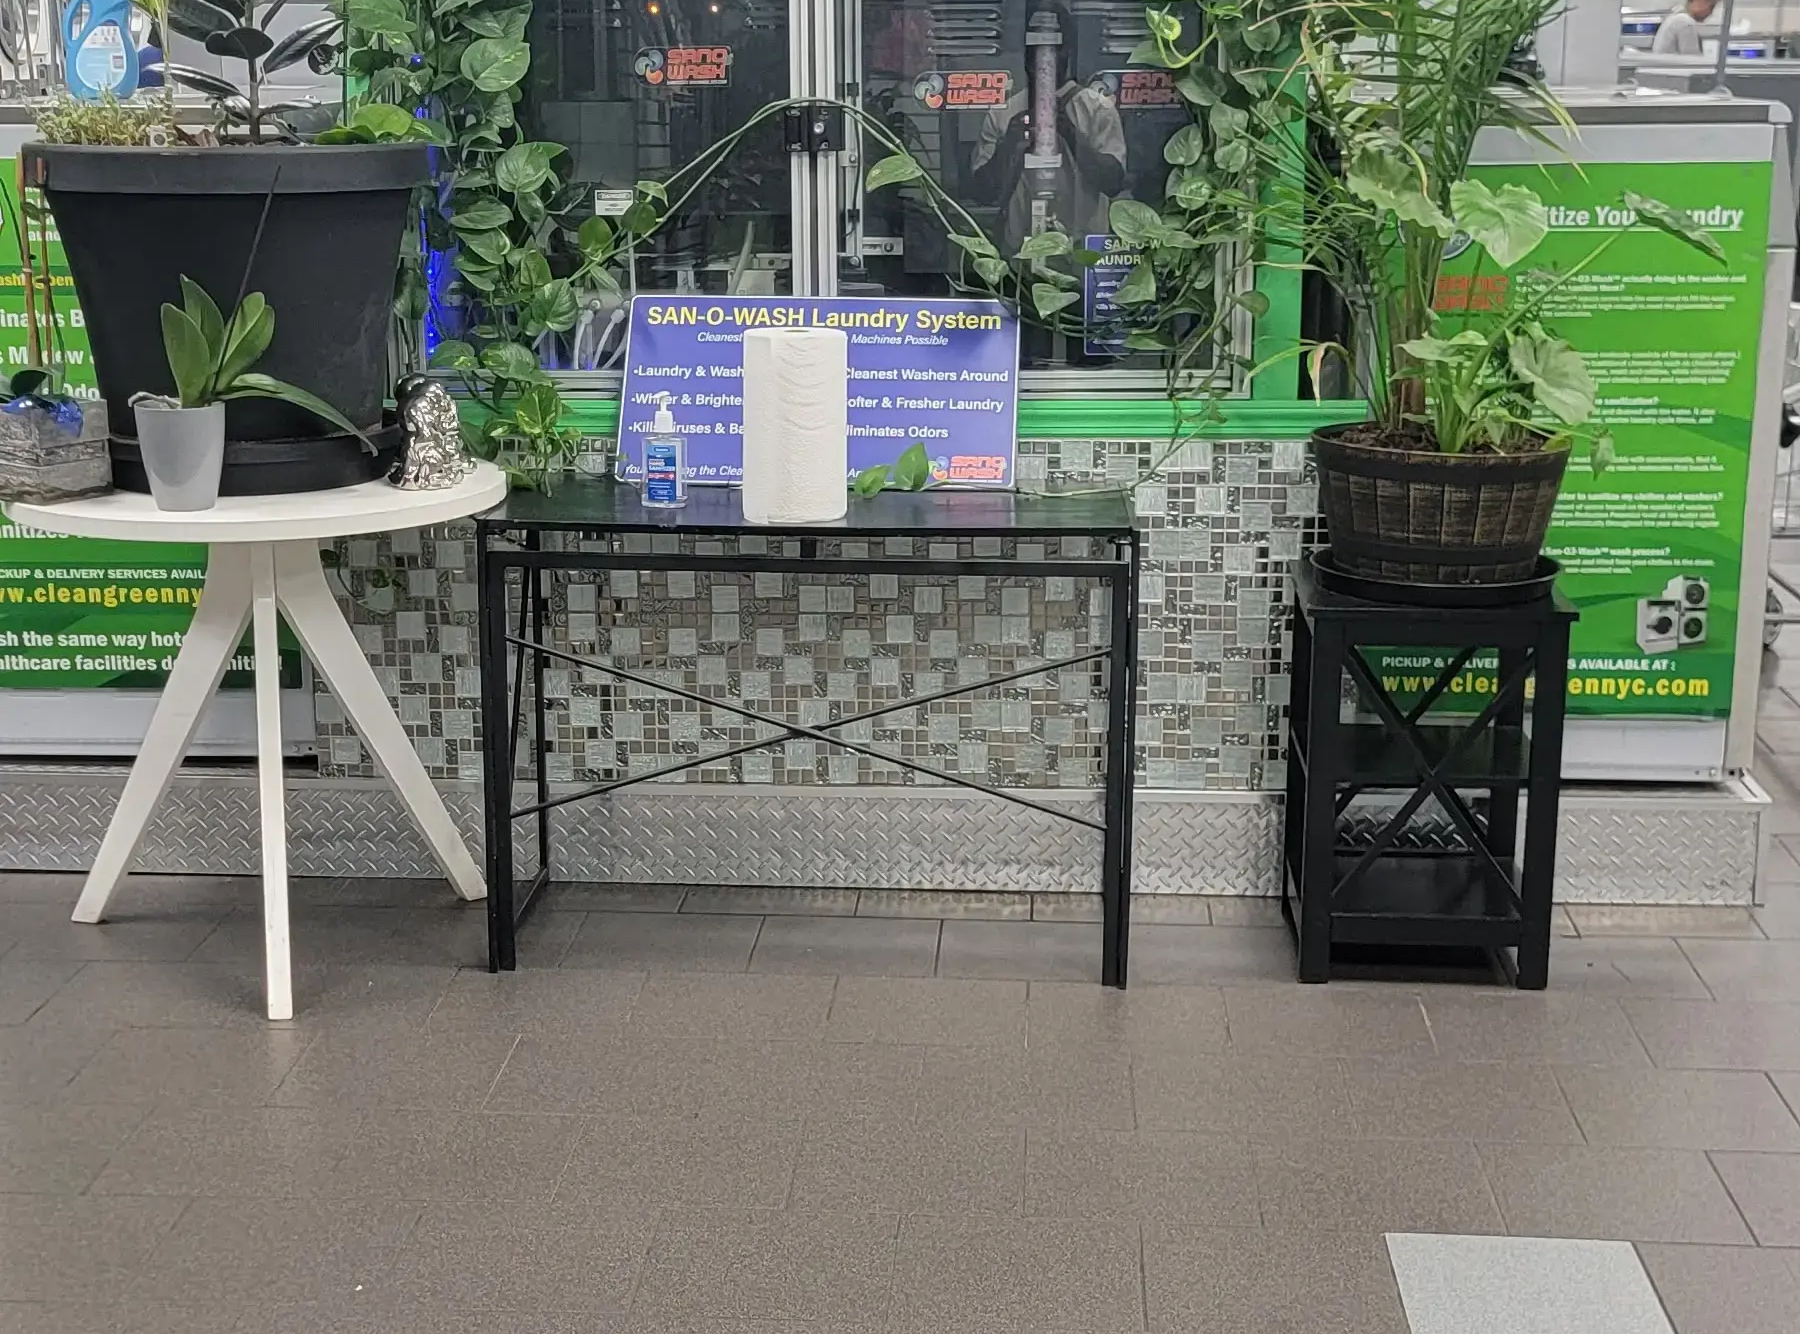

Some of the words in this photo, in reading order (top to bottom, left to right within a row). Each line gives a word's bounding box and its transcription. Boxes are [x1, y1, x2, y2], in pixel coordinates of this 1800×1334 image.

[668, 49, 727, 63] SANO
[667, 65, 726, 79] WASH
[947, 73, 1007, 88] SANO
[947, 89, 1005, 103] WASH
[1595, 205, 1638, 226] You
[1692, 205, 1744, 230] ndry
[647, 306, 804, 326] SAN-O-WASH
[813, 308, 910, 333] Laundry
[916, 310, 1001, 334] System
[697, 331, 743, 343] Cleanest
[851, 334, 902, 345] Machines
[905, 334, 949, 346] Possible
[638, 365, 692, 379] Laundry
[695, 366, 706, 377] &
[845, 367, 897, 380] Cleanest
[902, 369, 957, 381] Washers
[960, 369, 1009, 382] Around
[681, 393, 692, 405] &
[696, 394, 744, 408] Brighte
[847, 396, 878, 408] ofter
[881, 397, 892, 408] &
[896, 397, 946, 410] Fresher
[949, 398, 1004, 413] Laundry
[673, 423, 711, 434] iruses
[714, 423, 725, 434] &
[846, 425, 905, 438] liminates
[908, 426, 949, 438] Odors
[699, 466, 717, 475] the
[719, 465, 744, 476] Clea
[0, 569, 31, 579] CKUP
[34, 569, 45, 579] &
[47, 569, 105, 579] DELIVERY
[108, 569, 167, 579] SERVICES
[171, 569, 206, 579] AVAIL
[0, 631, 18, 647] sh
[22, 631, 53, 647] the
[57, 634, 108, 647] same
[111, 634, 149, 650] way
[74, 655, 158, 671] facilities
[1382, 656, 1430, 668] PICKUP
[1433, 657, 1445, 668] &
[1579, 658, 1650, 671] AVAILABLE
[1652, 659, 1668, 671] AT
